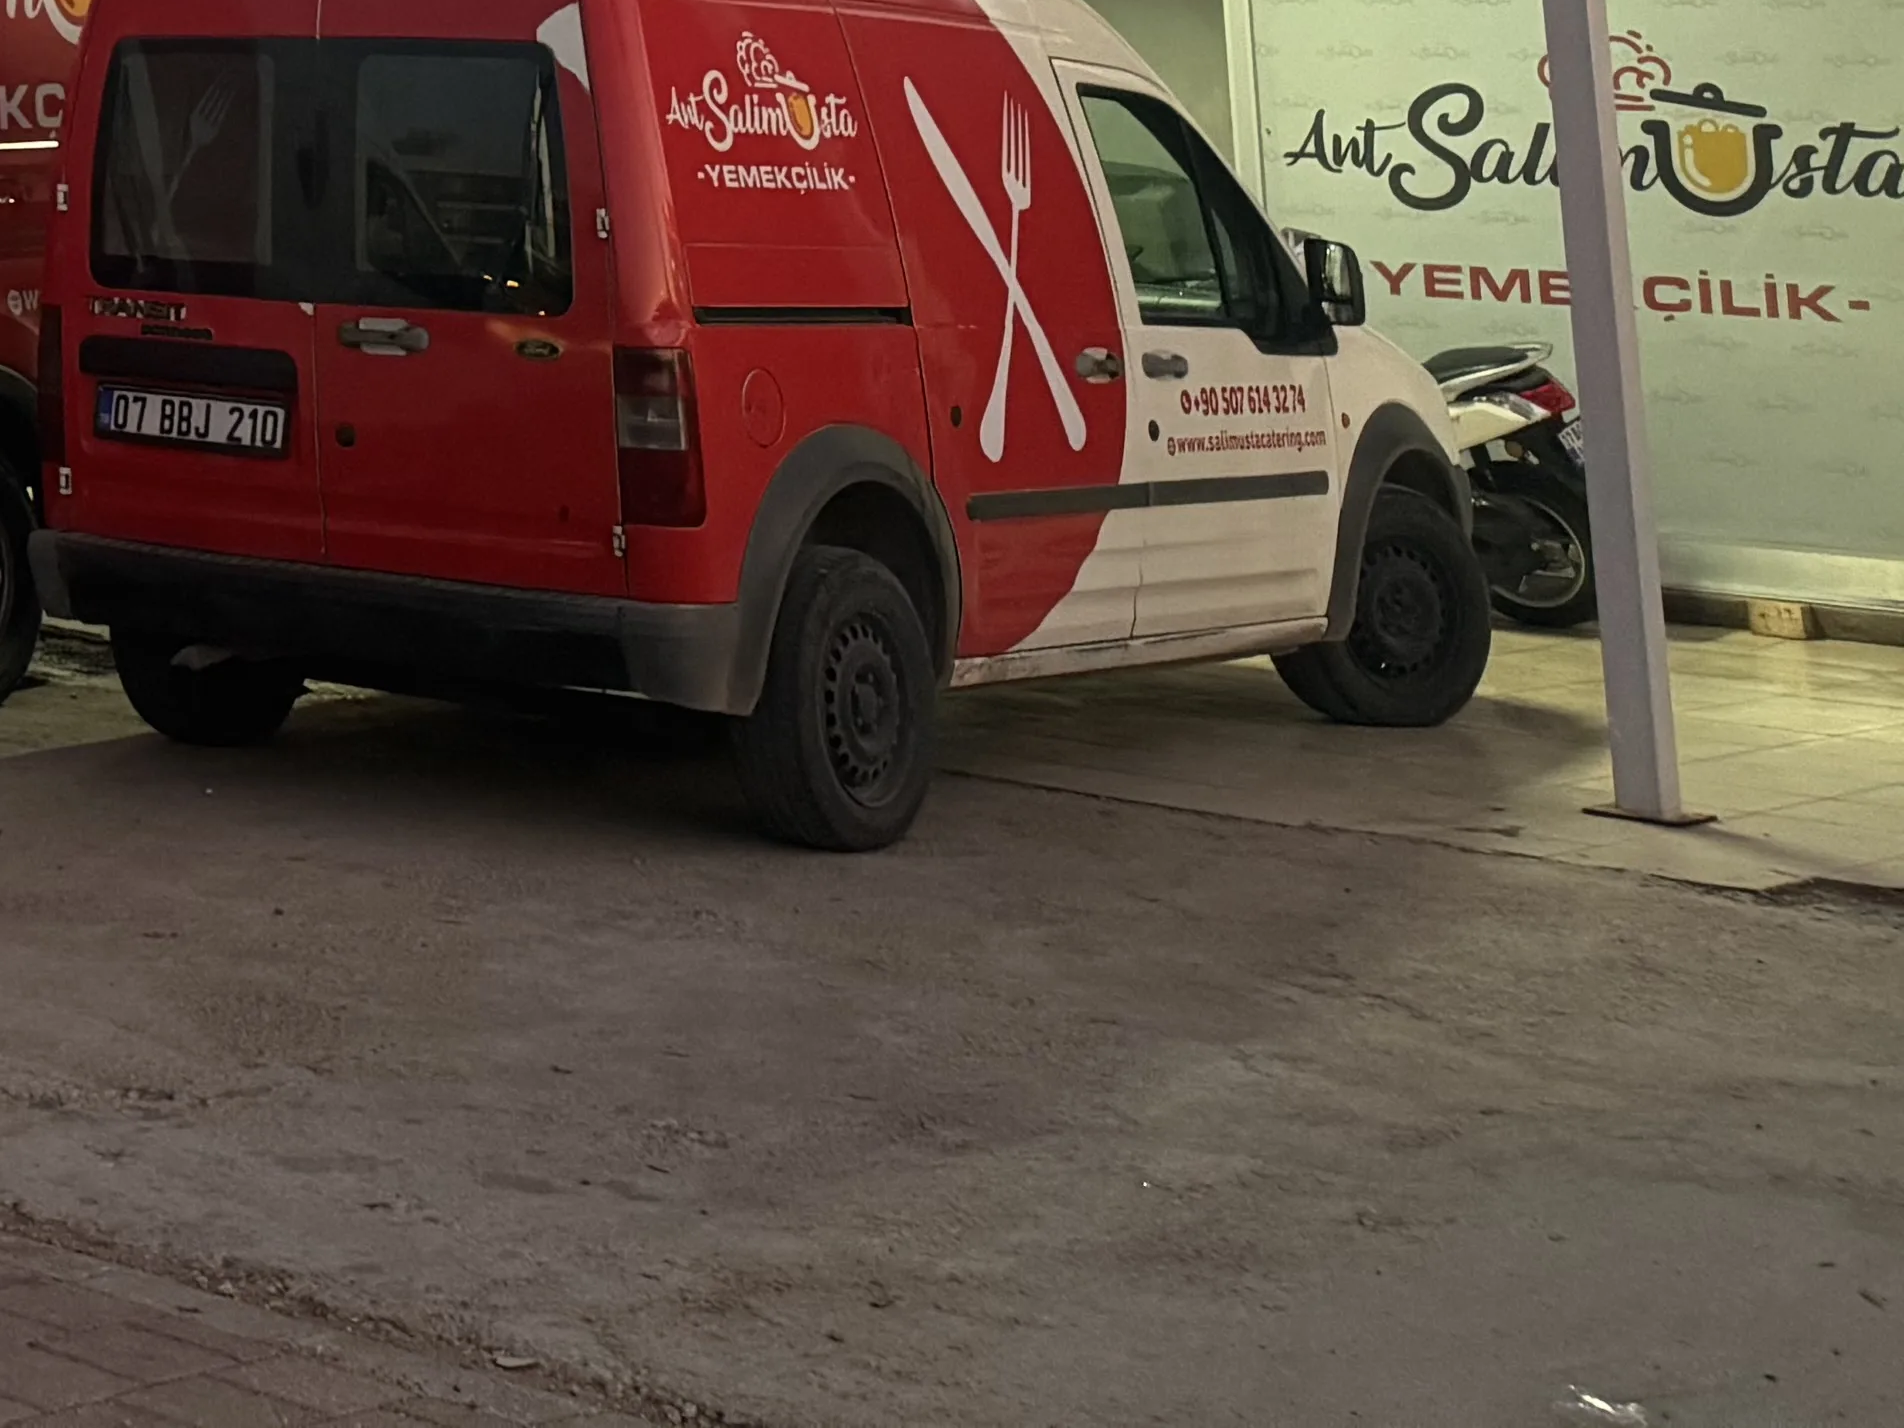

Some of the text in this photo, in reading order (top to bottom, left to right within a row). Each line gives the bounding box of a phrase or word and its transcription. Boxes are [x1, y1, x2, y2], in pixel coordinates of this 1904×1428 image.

[666, 86, 705, 131] Ant
[1283, 107, 1405, 179] Ant
[1369, 259, 1871, 323] YEMEÇİLİK-
[113, 393, 279, 447] 07 BBJ 210
[1194, 387, 1219, 416] +90
[1221, 386, 1244, 416] 507
[1247, 385, 1271, 414] 614
[1176, 425, 1327, 453] www.salimustacatering.com
